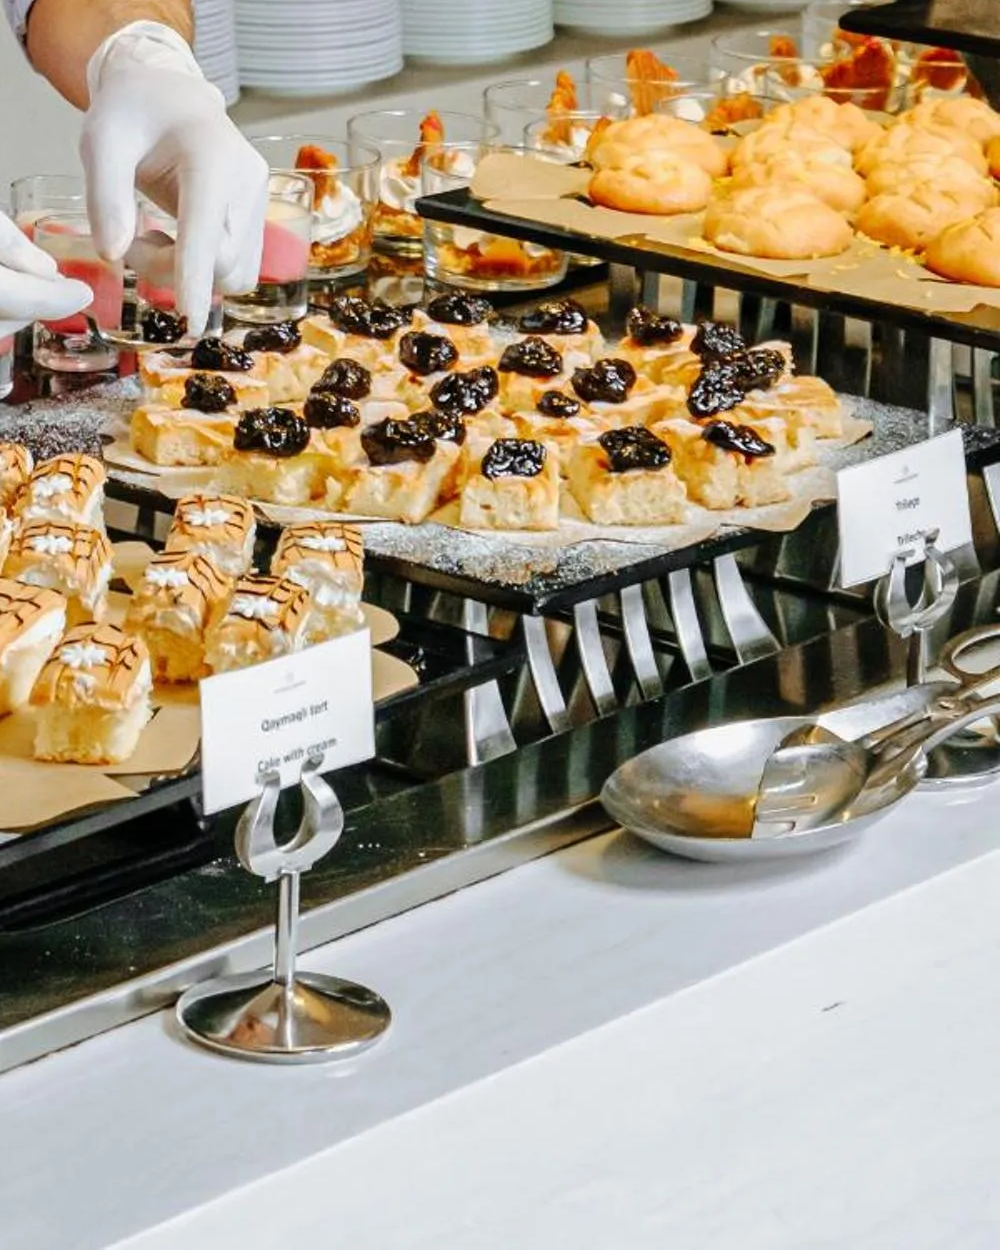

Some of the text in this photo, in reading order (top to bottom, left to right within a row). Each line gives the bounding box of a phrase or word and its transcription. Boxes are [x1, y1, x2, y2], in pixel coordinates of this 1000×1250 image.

[309, 700, 328, 716] tort
[258, 737, 337, 773] Cake with cream
